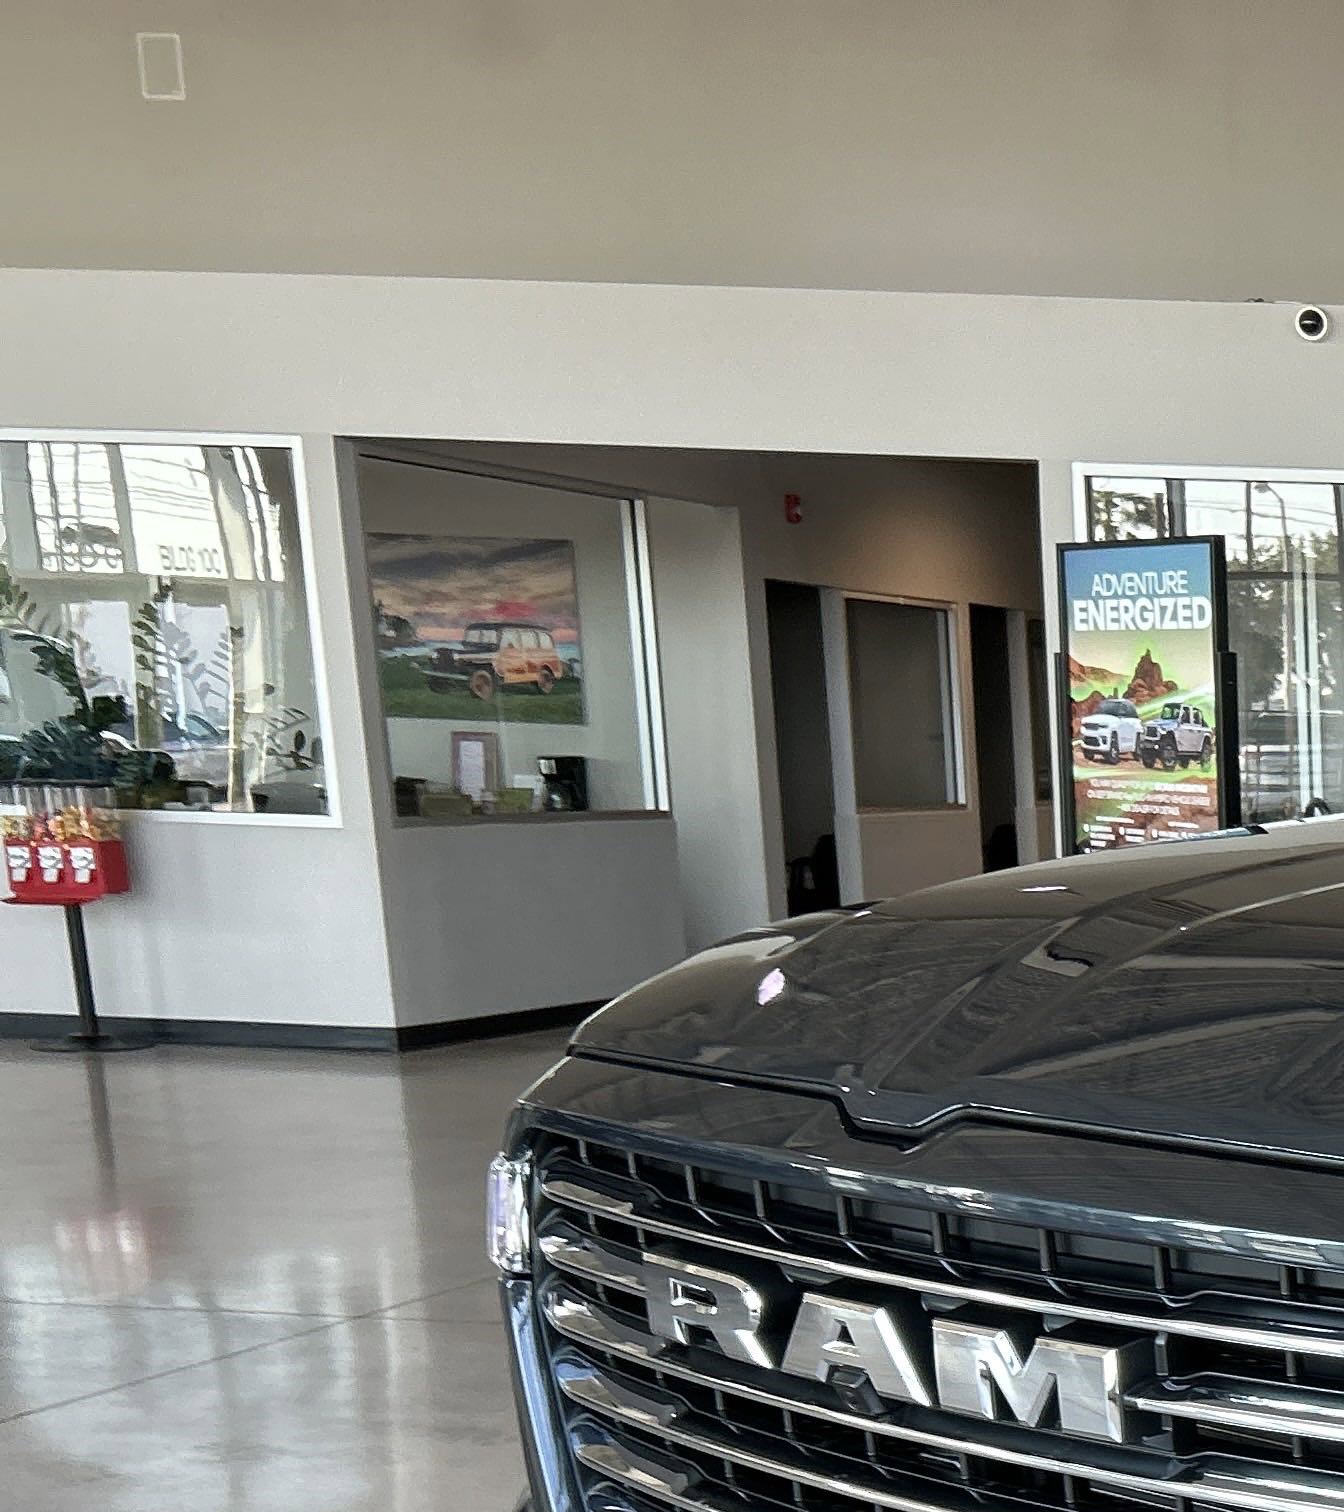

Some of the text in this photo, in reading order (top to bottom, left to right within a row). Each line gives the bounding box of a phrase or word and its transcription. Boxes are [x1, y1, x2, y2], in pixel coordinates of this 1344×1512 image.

[1092, 571, 1188, 597] ADVENTURE
[1073, 597, 1212, 631] ENERGIZED
[642, 1251, 1130, 1444] RAM
